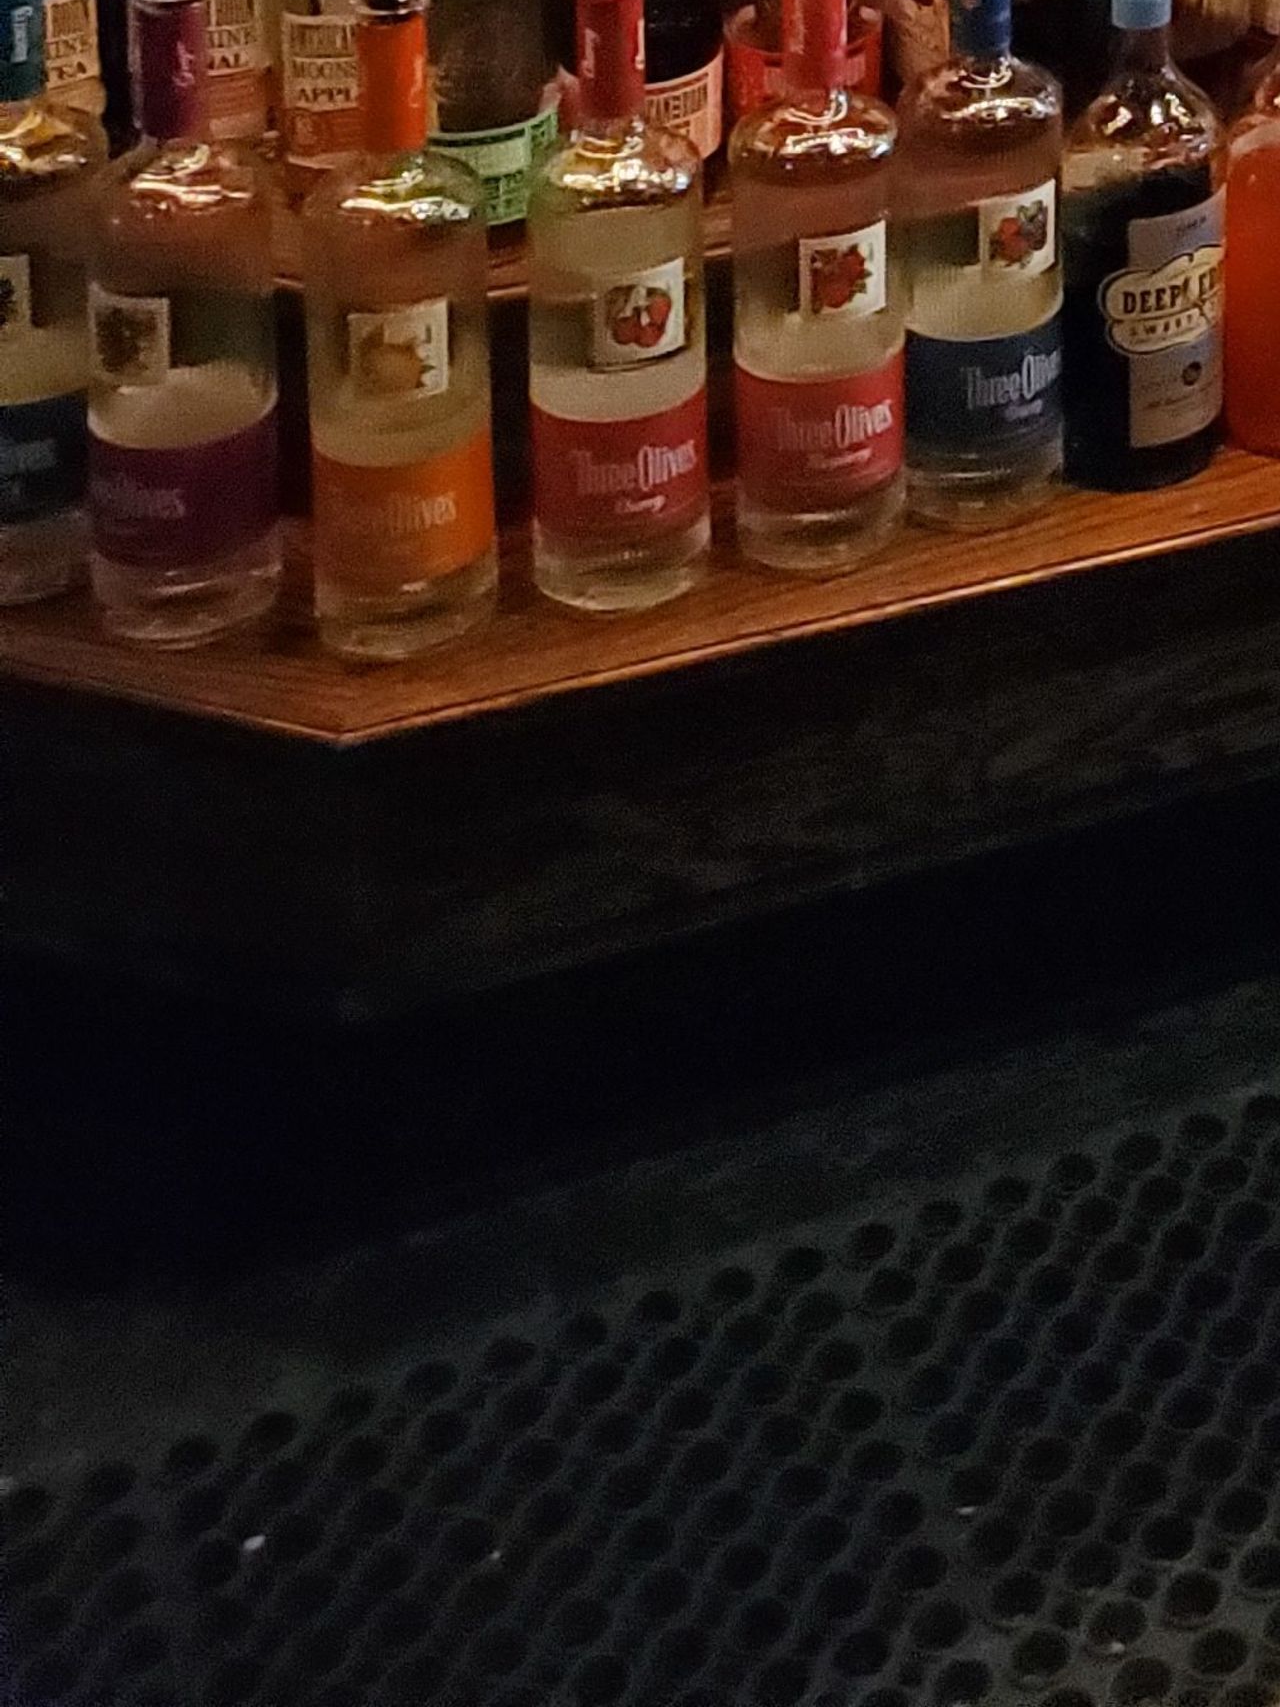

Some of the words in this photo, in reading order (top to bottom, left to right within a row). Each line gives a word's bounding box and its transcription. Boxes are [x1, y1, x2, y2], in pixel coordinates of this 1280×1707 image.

[1122, 284, 1185, 316] DEEP
[833, 398, 893, 450] Olives
[636, 437, 697, 492] Olives
